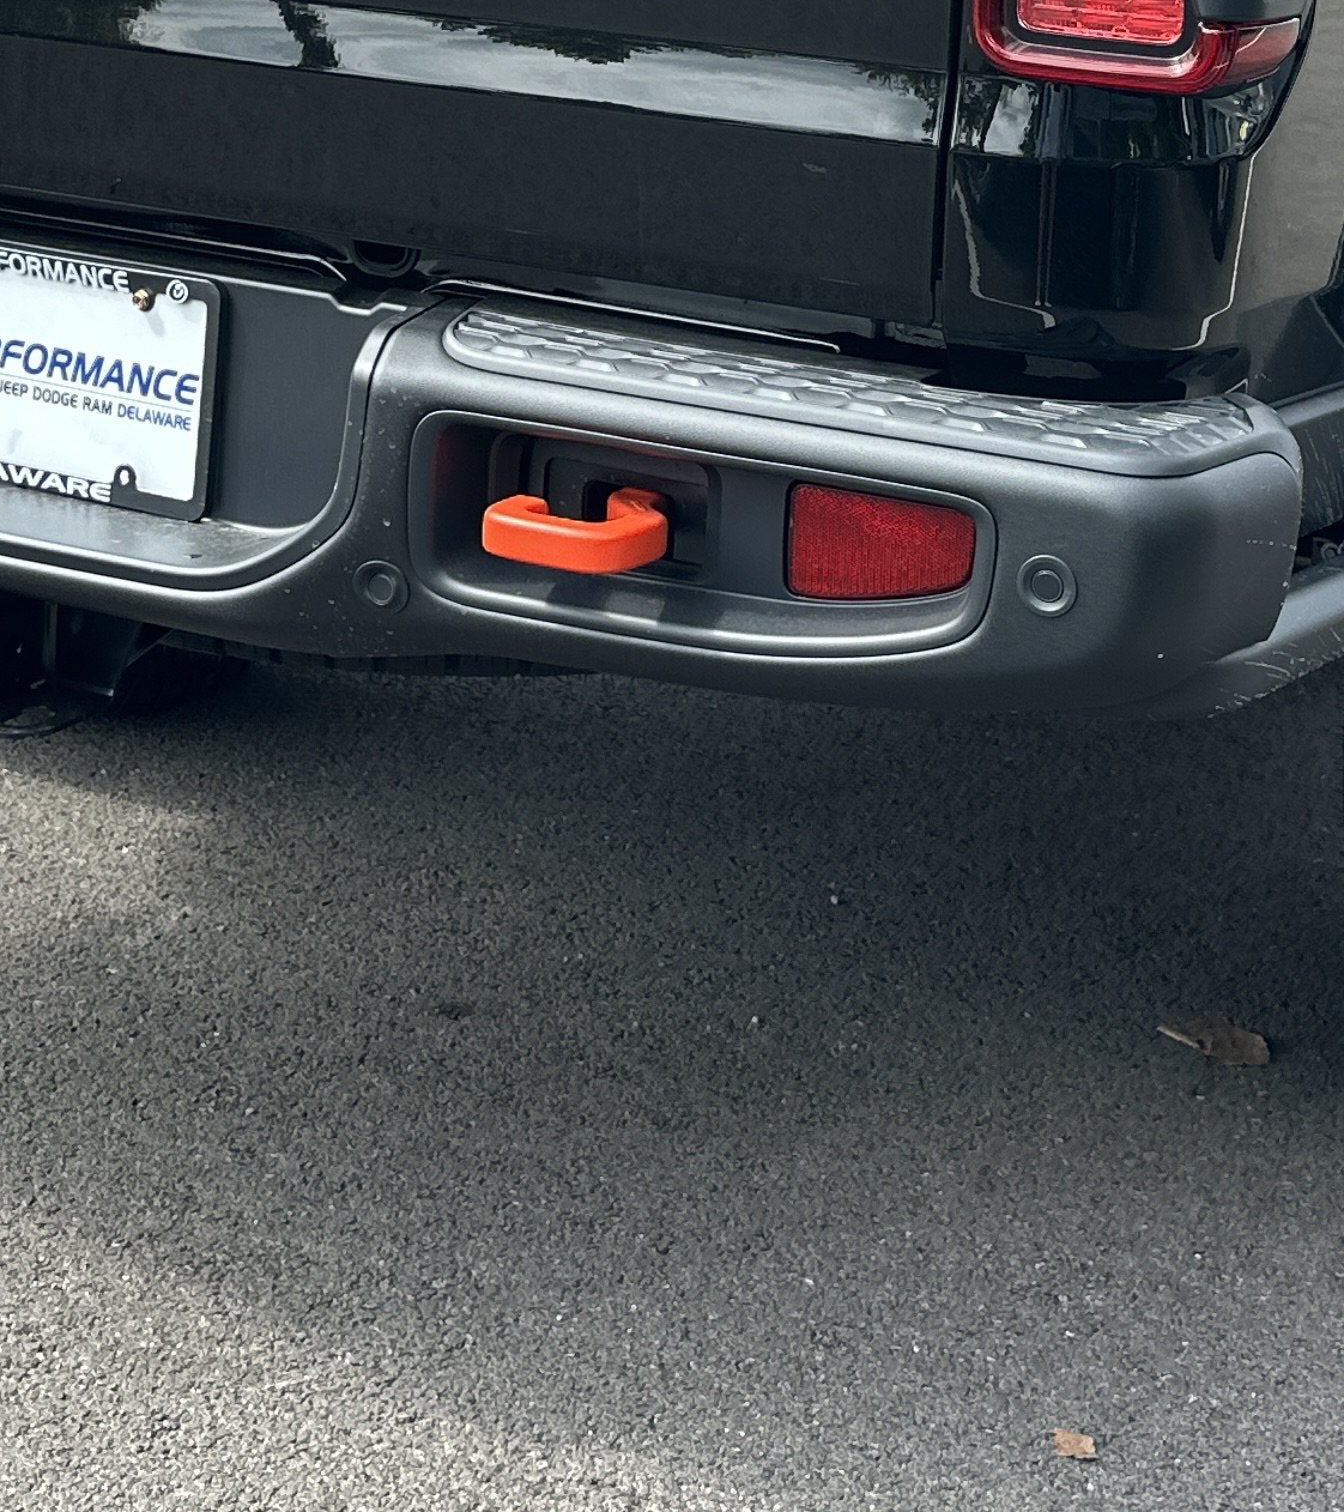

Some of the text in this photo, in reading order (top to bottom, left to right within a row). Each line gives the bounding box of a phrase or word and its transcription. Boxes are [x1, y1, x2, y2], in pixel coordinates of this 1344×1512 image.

[32, 386, 79, 409] DODGE
[82, 396, 113, 416] RAM
[117, 403, 192, 432] DELAWARE
